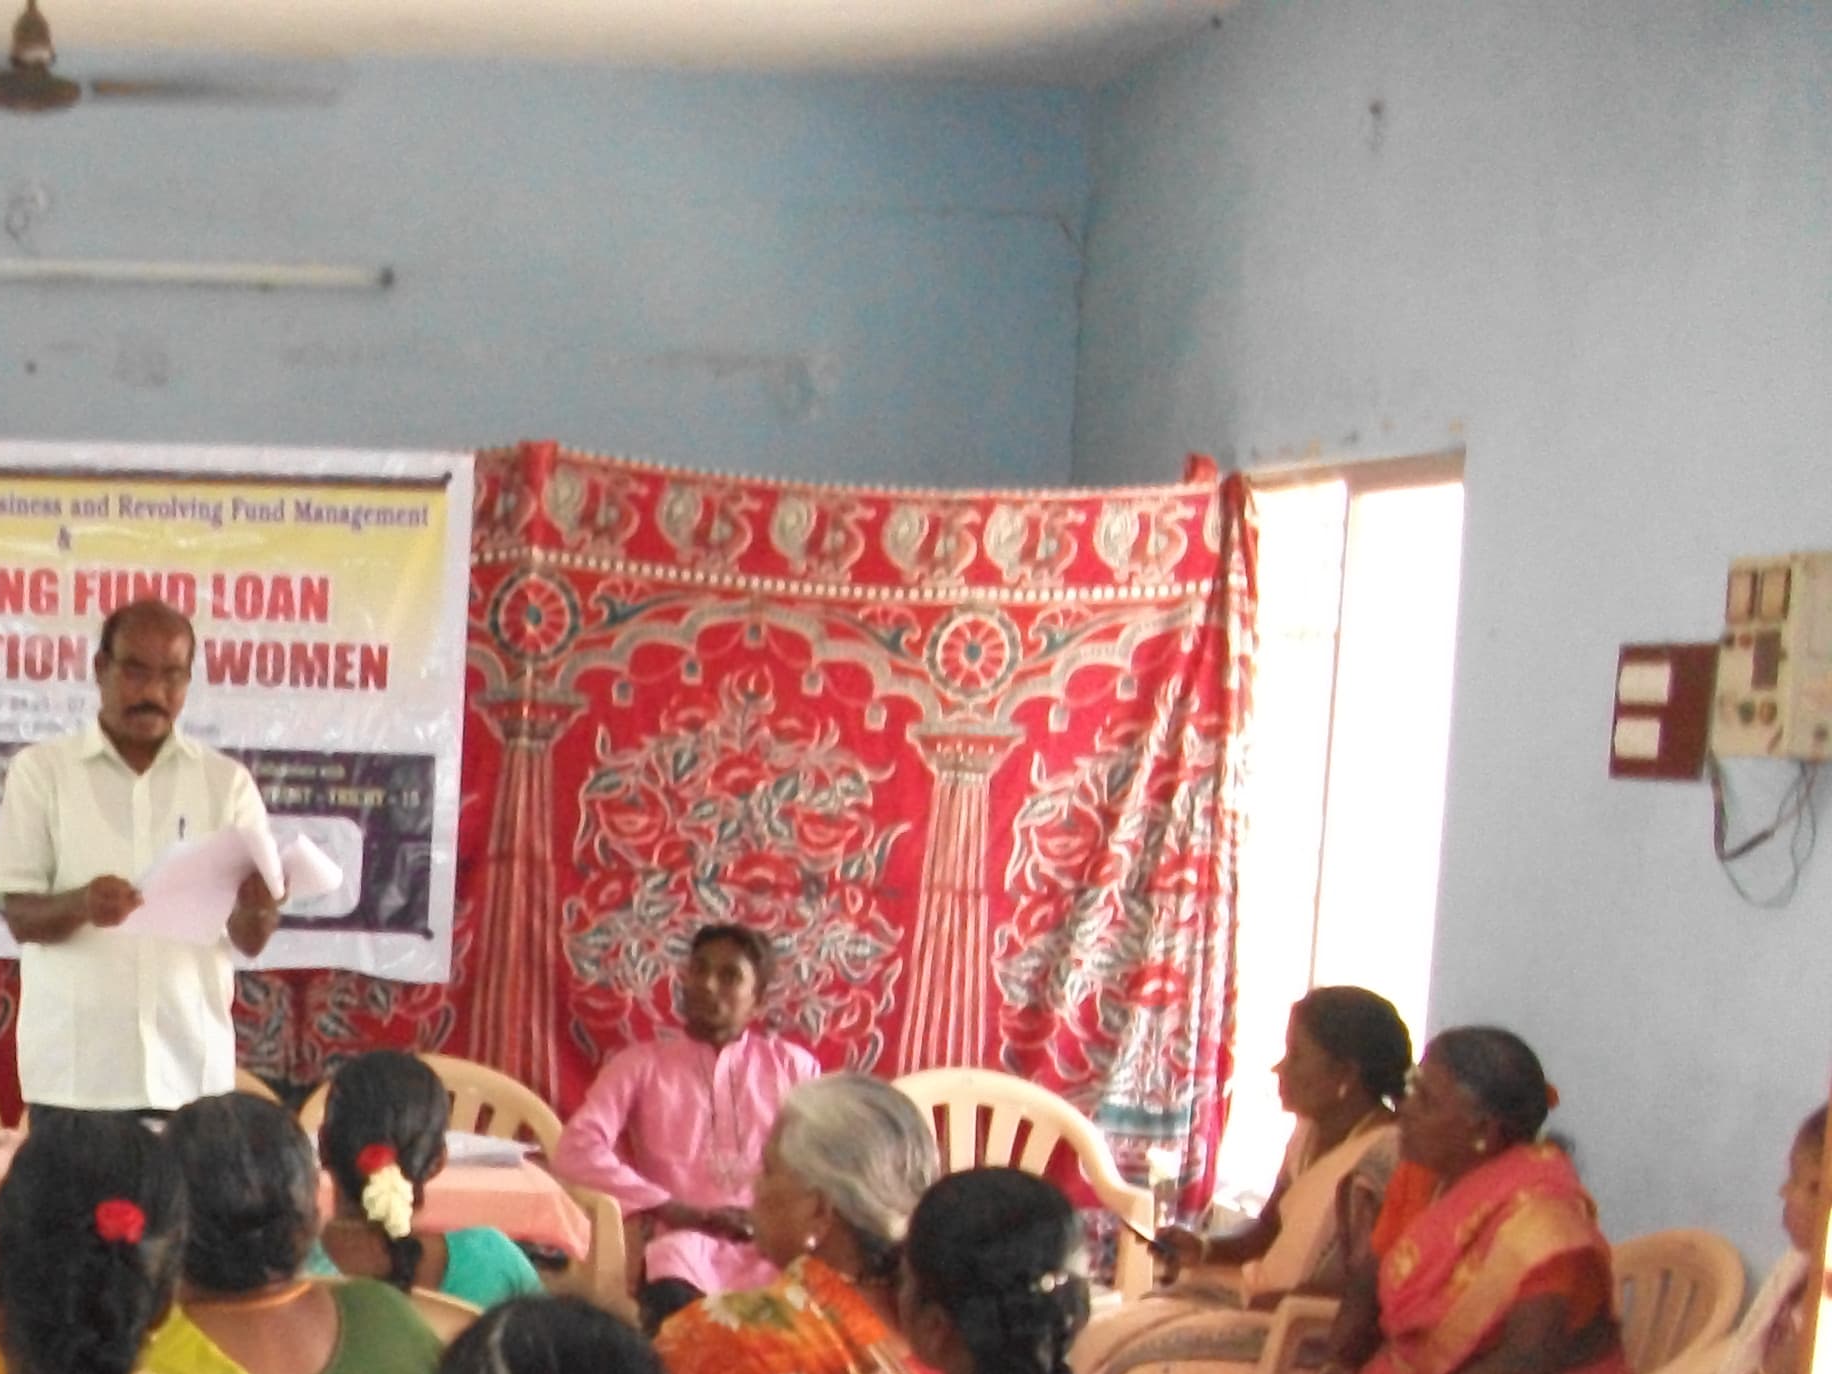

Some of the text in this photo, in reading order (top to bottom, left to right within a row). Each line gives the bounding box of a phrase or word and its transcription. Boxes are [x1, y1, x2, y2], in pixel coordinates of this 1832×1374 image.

[70, 493, 110, 518] and
[119, 493, 223, 528] Revolving
[231, 496, 285, 522] Fund
[294, 498, 429, 531] Management
[73, 569, 197, 620] FUND
[211, 572, 330, 623] LOAN
[203, 639, 390, 691] WOMEN
